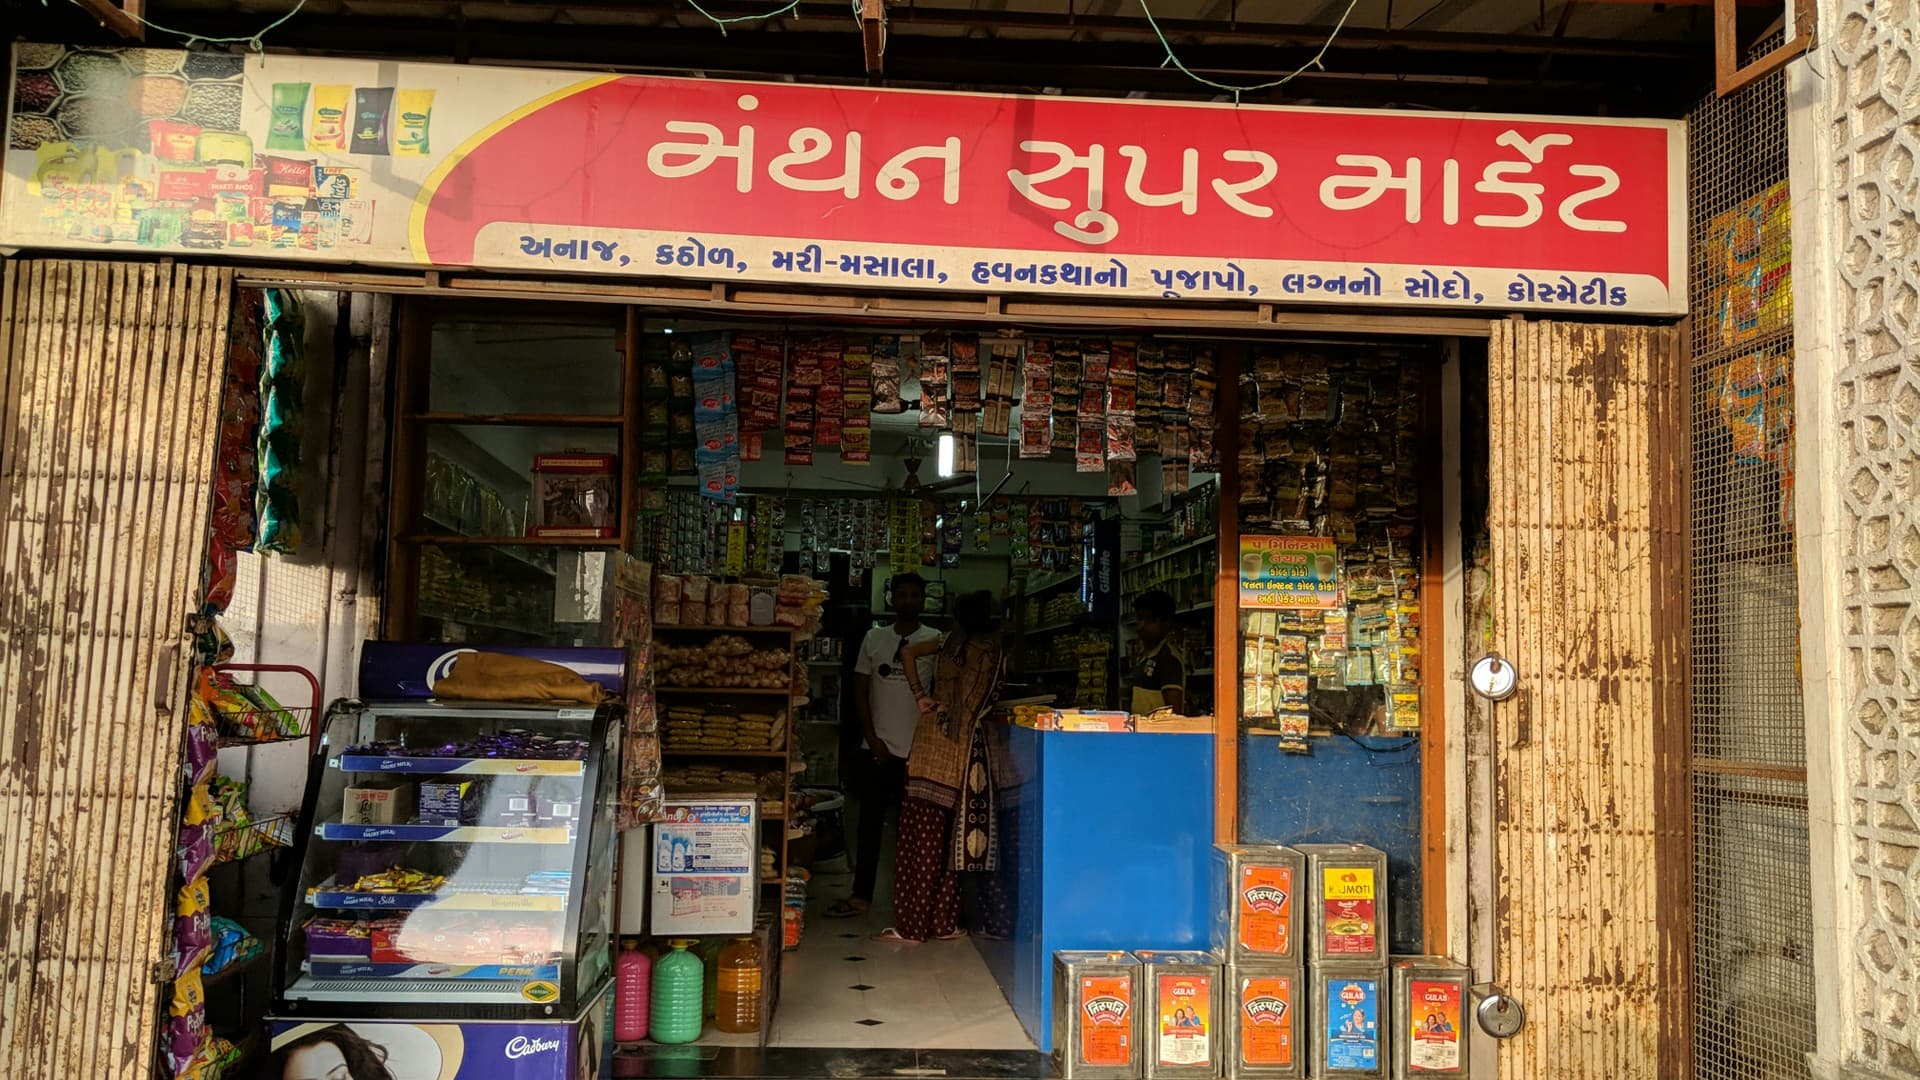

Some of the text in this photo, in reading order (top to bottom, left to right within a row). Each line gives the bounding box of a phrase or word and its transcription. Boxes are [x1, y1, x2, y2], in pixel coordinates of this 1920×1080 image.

[647, 94, 1628, 245] મંથન સુપર માર્કેટ
[519, 235, 1628, 307] અનાજ, કઠોળ, મરી-મસાલા, હવનકથાનો પૂજાપો, લગ્નનો સોદો, કોસ્મેટીક
[505, 1035, 560, 1060] Cadbury
